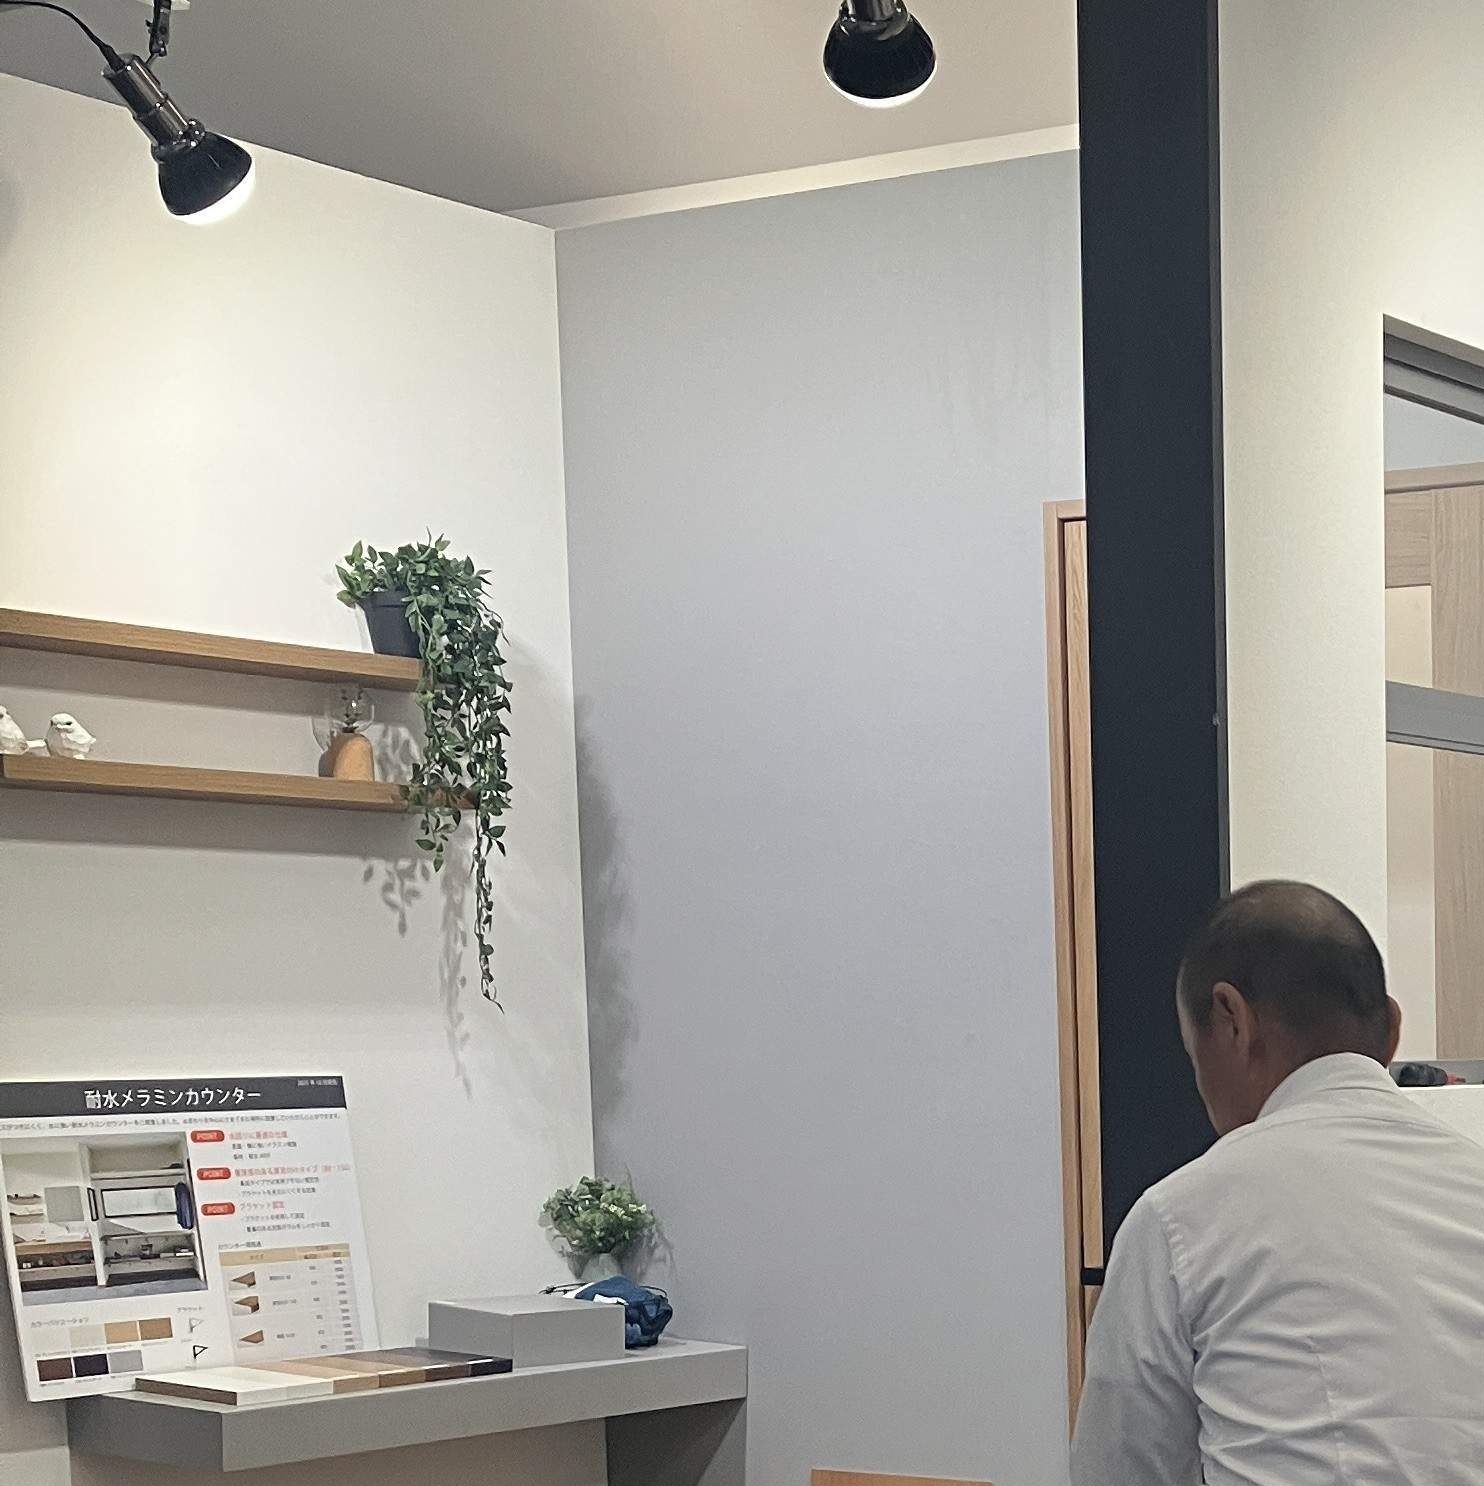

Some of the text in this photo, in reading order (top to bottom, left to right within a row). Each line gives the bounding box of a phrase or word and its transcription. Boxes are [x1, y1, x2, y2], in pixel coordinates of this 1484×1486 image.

[84, 1087, 261, 1109] 耐水メラミンカウンター
